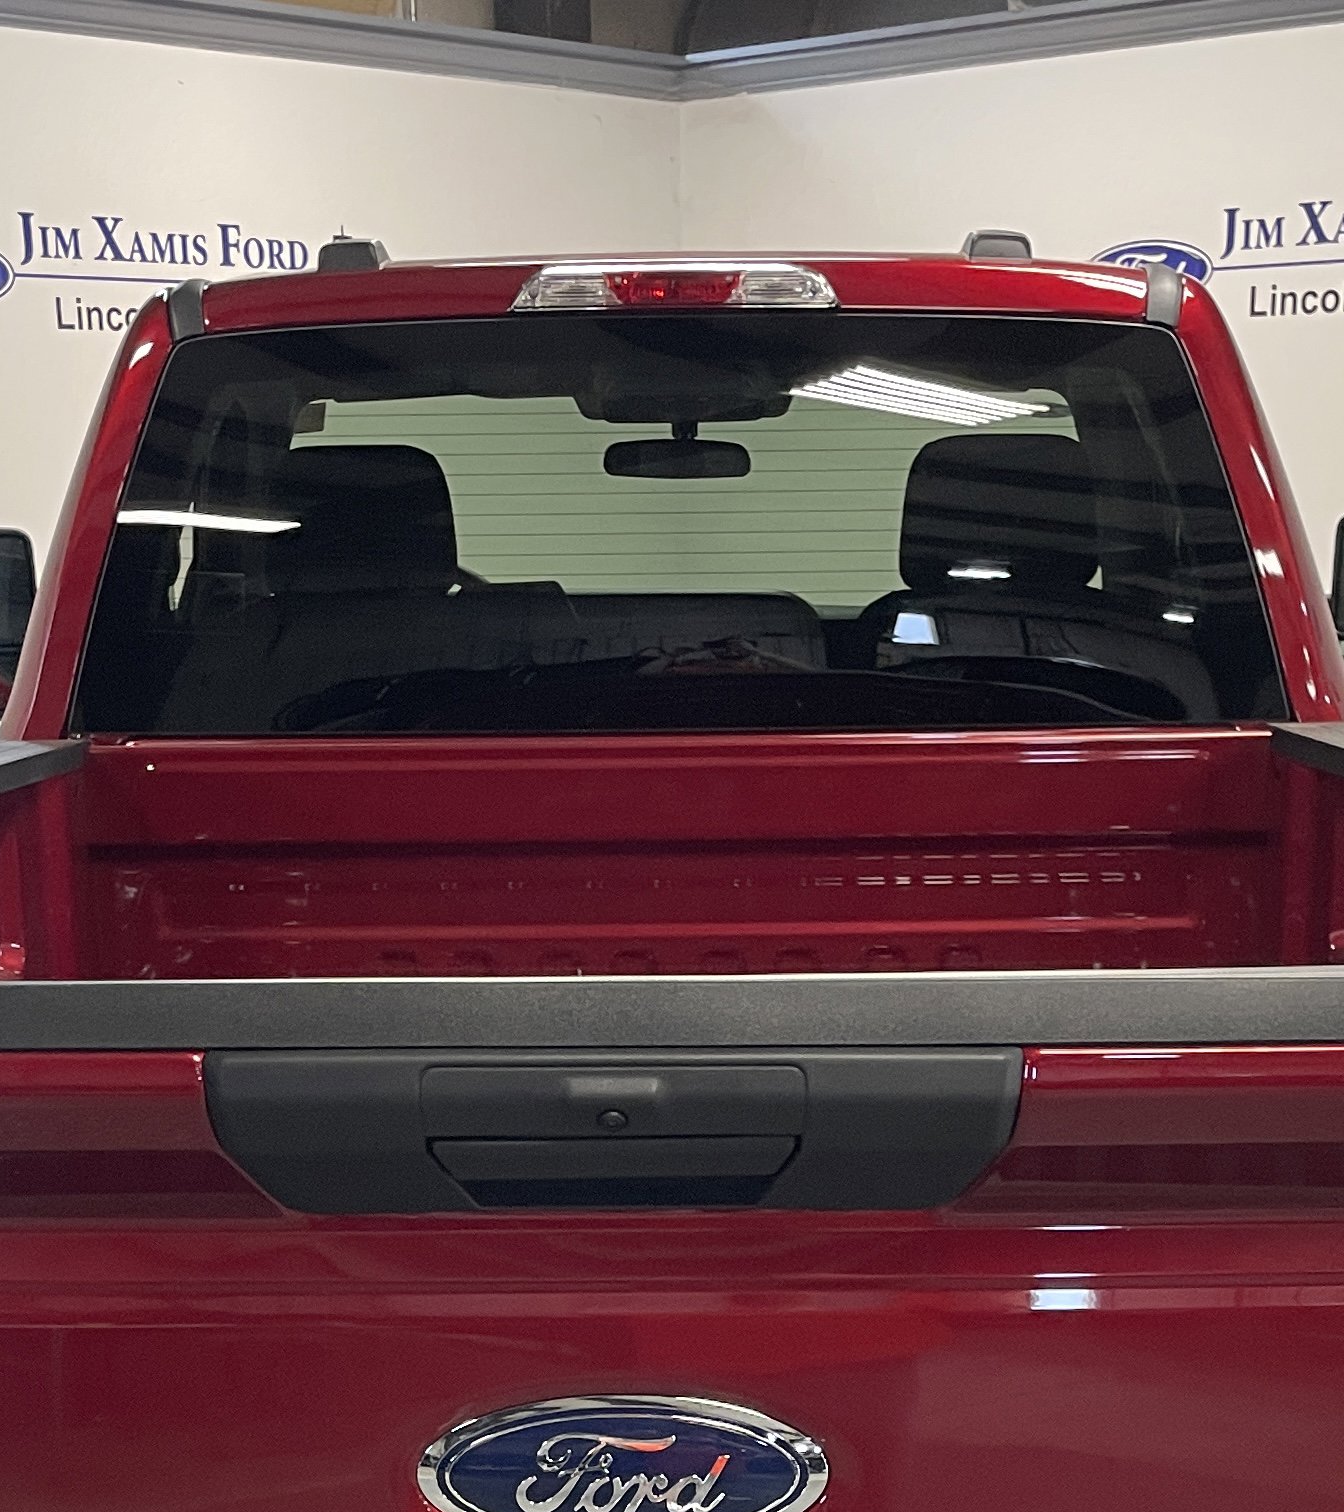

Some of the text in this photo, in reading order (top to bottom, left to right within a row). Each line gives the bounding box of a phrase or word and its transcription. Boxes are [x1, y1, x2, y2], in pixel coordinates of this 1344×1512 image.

[17, 211, 309, 270] JIM XAMIS FORD
[1219, 206, 1285, 259] JIM
